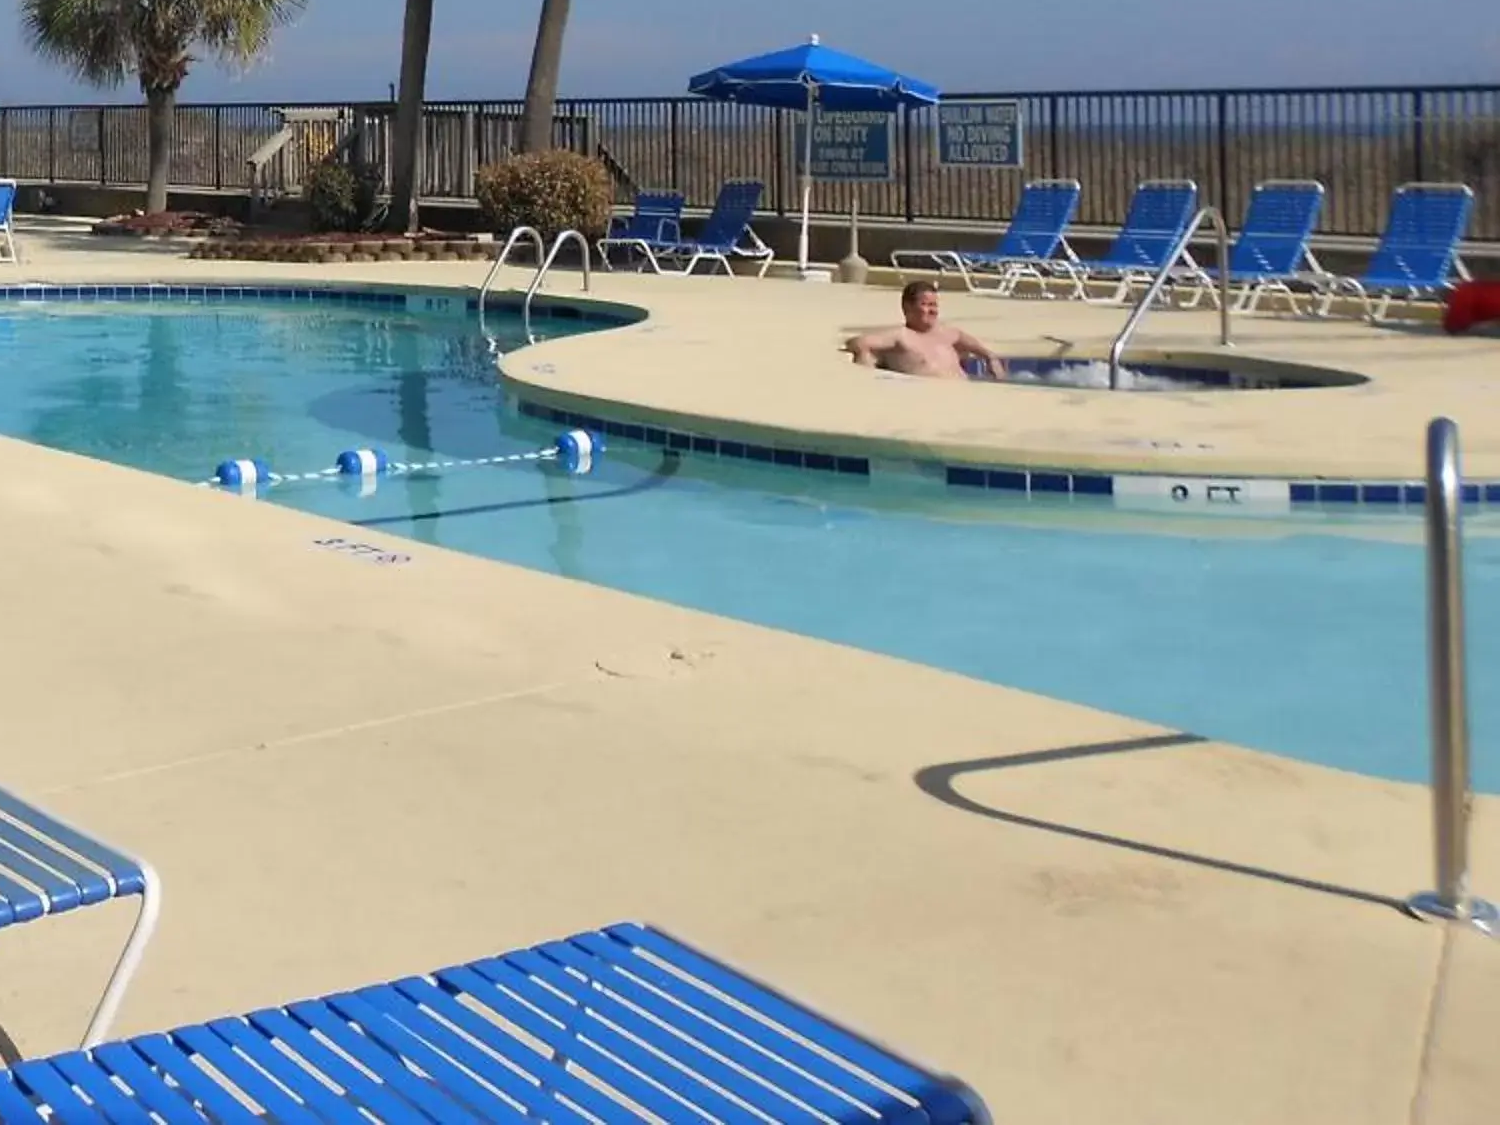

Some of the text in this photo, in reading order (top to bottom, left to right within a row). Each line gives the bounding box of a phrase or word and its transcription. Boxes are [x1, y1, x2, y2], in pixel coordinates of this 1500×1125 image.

[813, 125, 868, 144] ON DUTY
[946, 125, 1011, 144] NO DIVING
[948, 144, 1009, 162] ALLOWED
